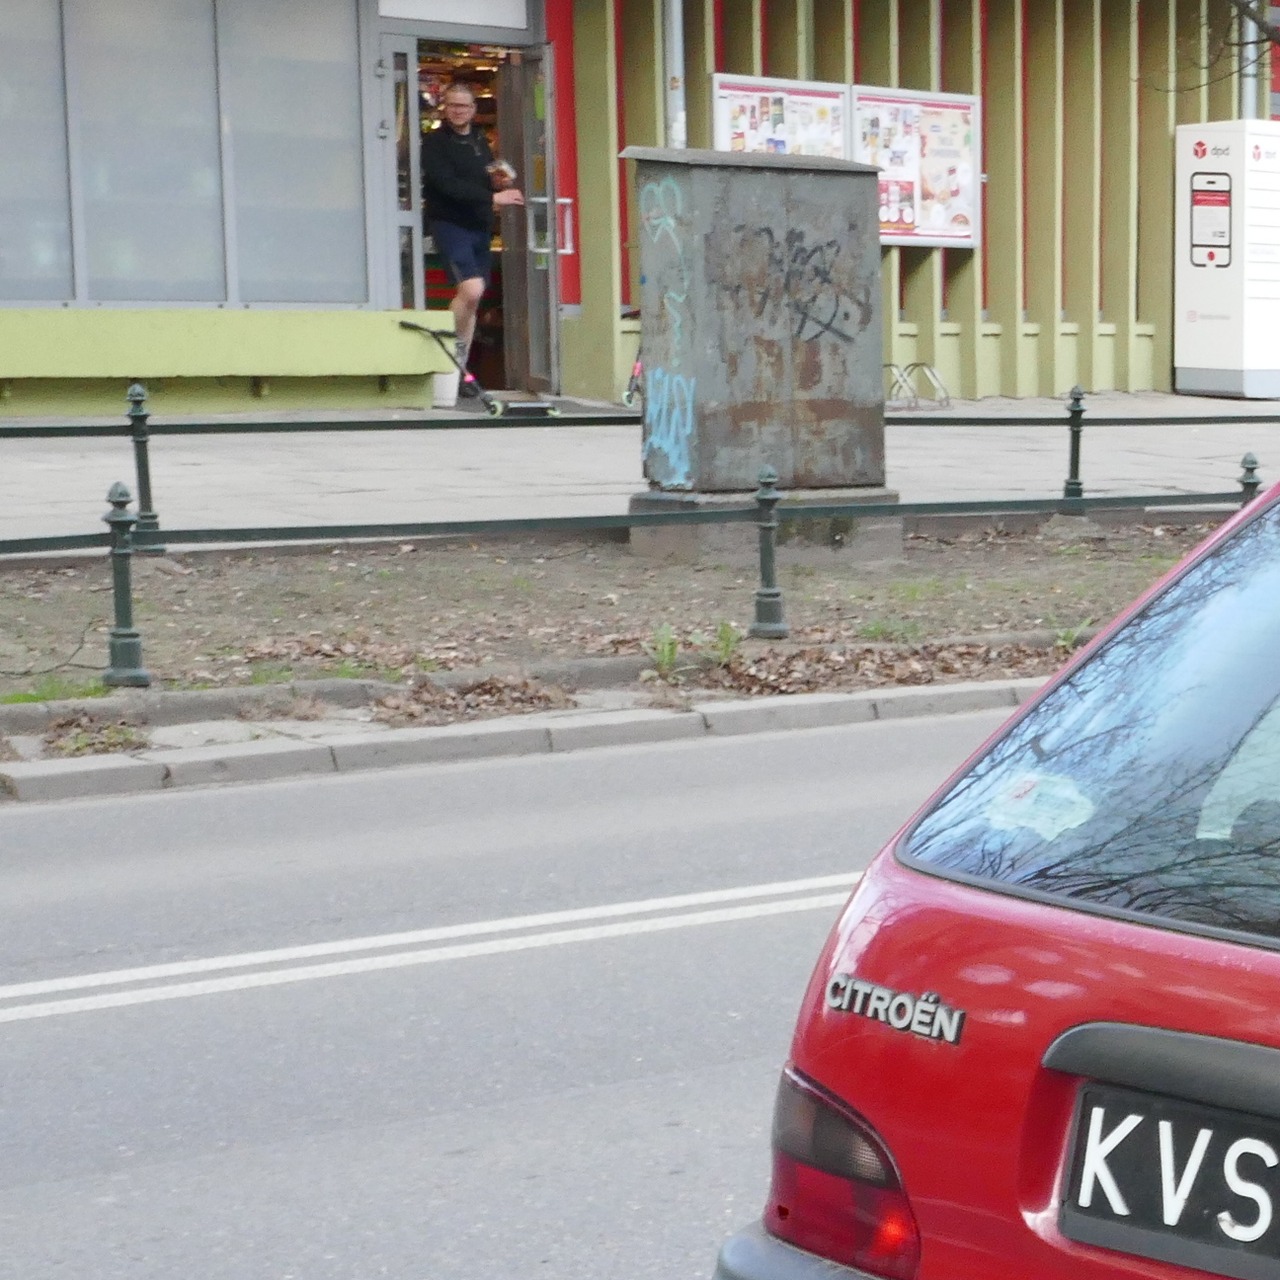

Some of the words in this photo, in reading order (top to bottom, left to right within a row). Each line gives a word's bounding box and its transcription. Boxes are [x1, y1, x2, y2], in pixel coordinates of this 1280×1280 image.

[1211, 146, 1230, 158] dpd
[825, 973, 965, 1044] CITROËN
[1078, 1106, 1280, 1243] KVS
